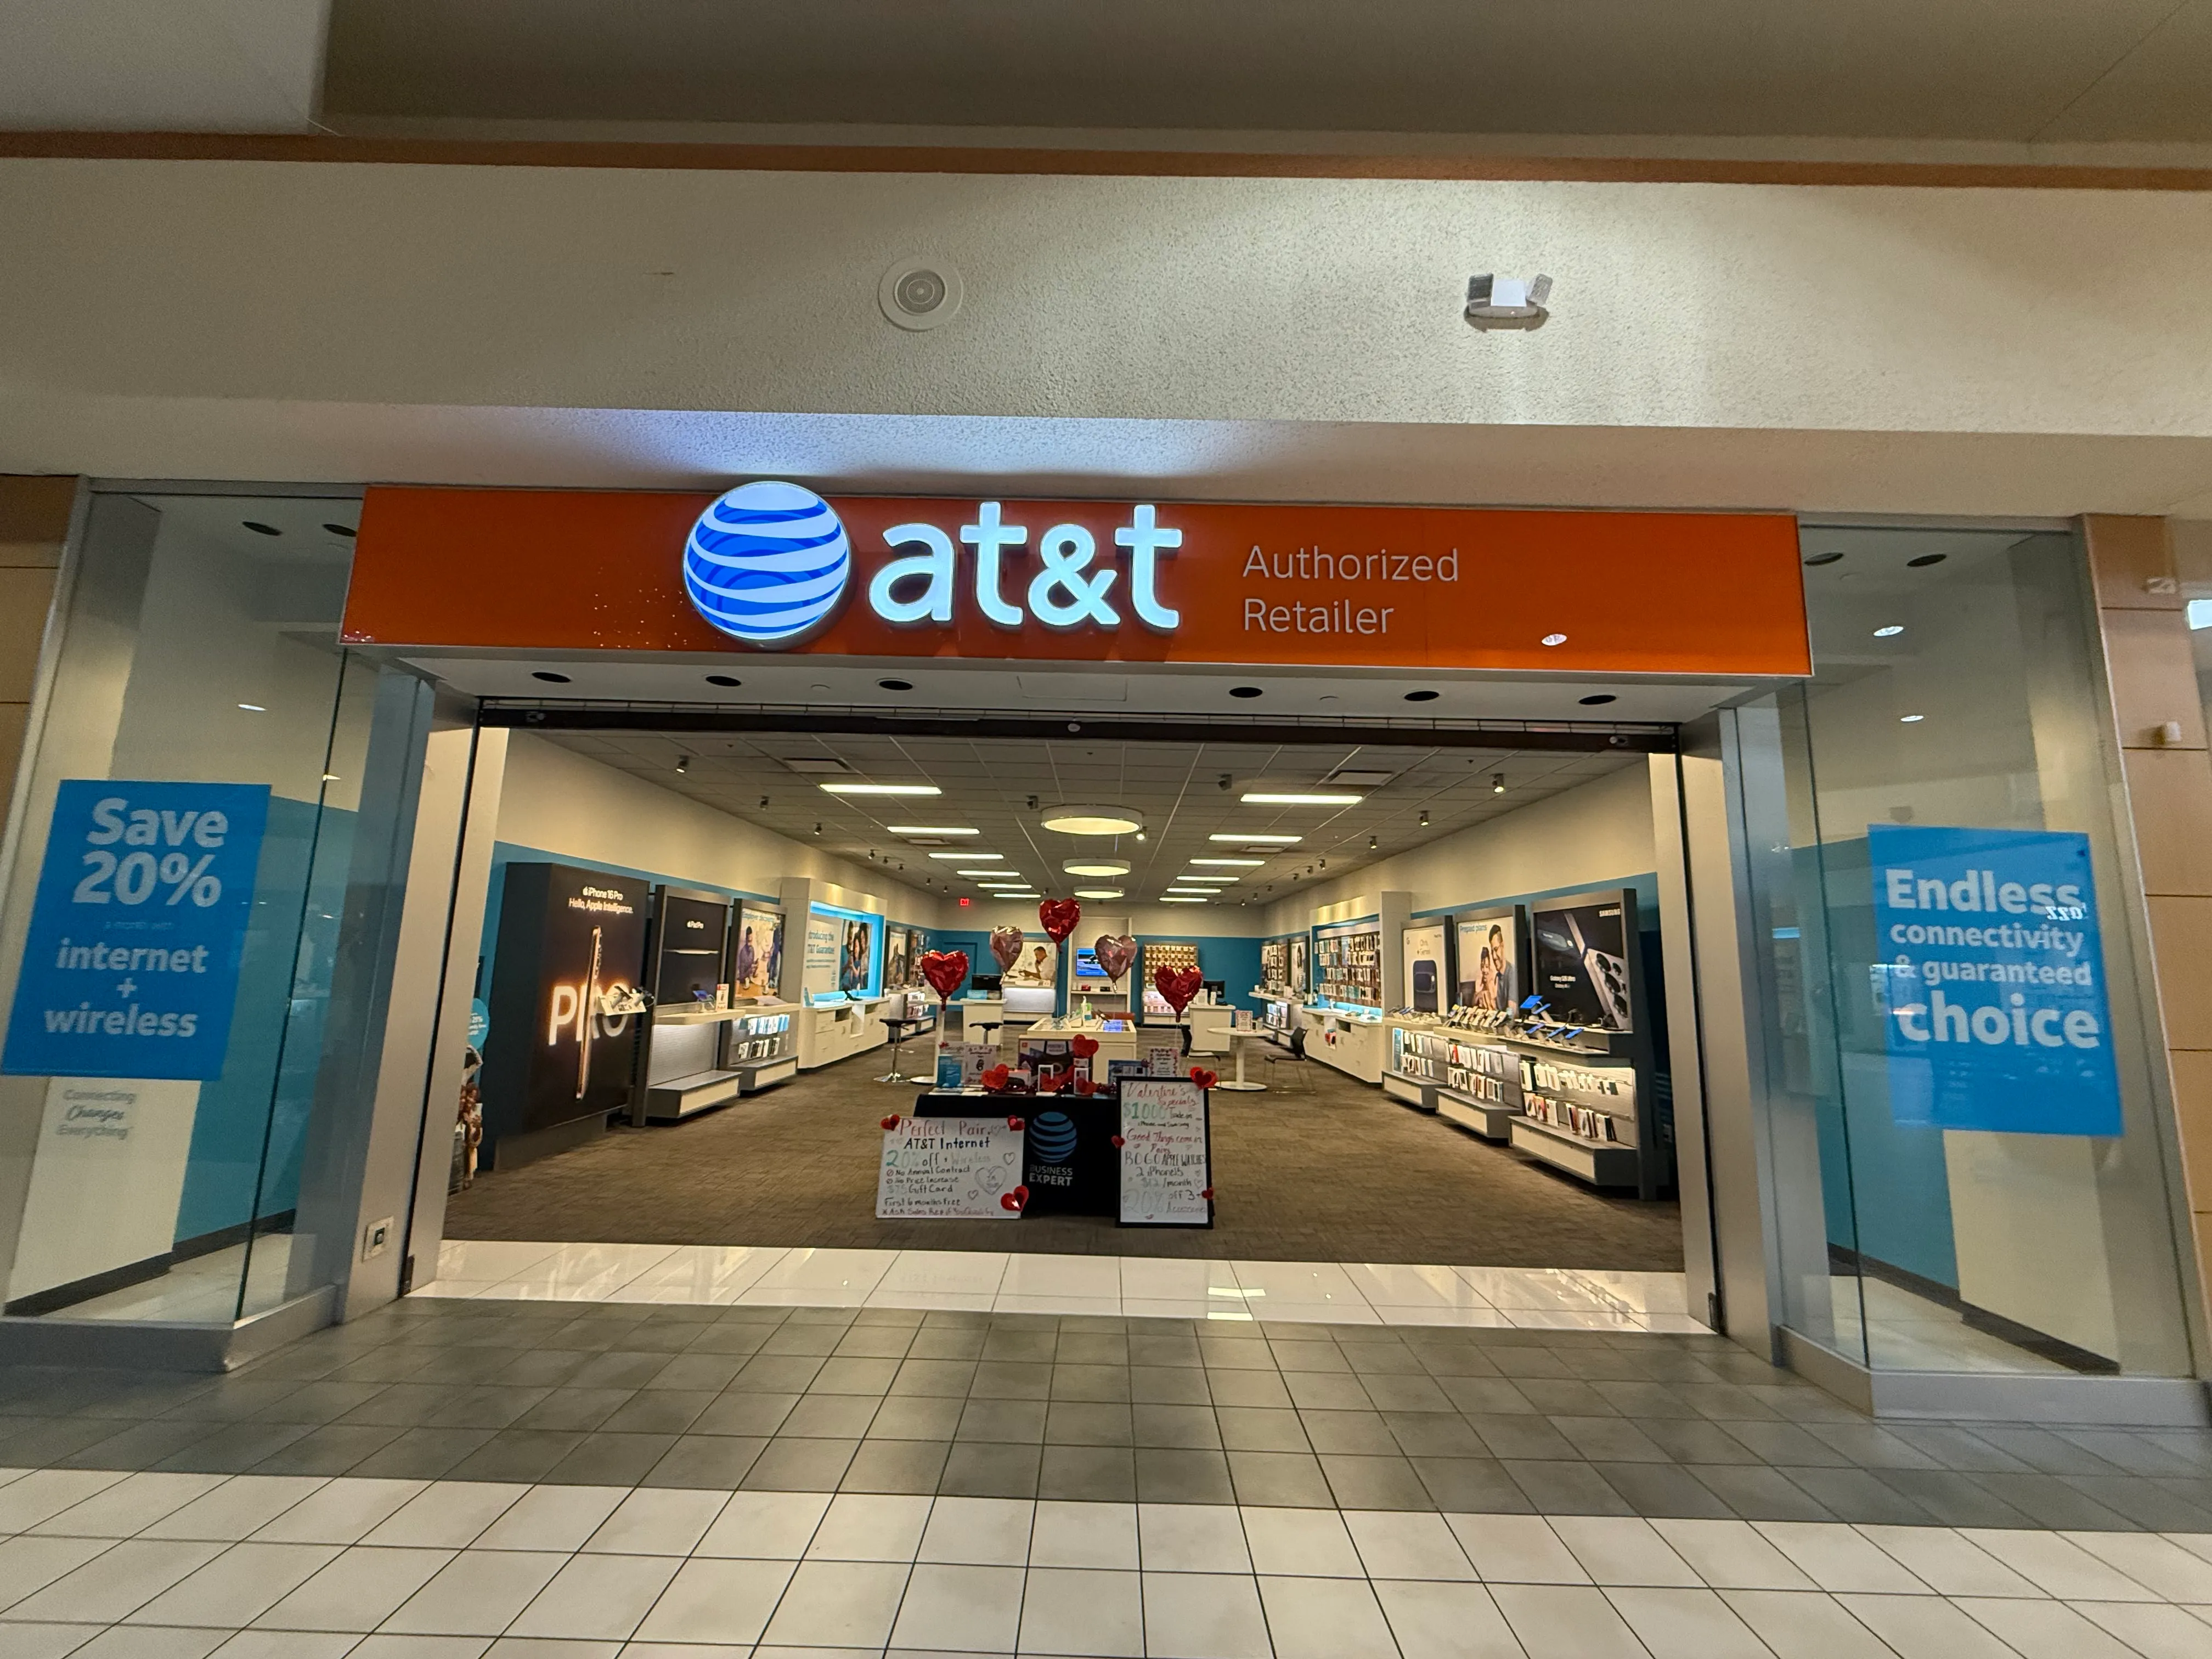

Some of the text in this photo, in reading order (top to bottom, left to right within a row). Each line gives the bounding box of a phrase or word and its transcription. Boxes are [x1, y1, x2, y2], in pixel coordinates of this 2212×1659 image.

[868, 501, 1183, 629] at&t
[1242, 545, 1459, 582] Authorized
[1242, 597, 1395, 634] Retailer
[86, 797, 228, 848] Save
[72, 850, 222, 907] 20%
[588, 887, 607, 899] iPhone
[614, 890, 624, 901] Pro
[1886, 868, 2084, 915] Endless
[586, 899, 603, 912] Apple
[1599, 909, 1621, 917] SAMSUNG
[1890, 922, 2084, 957] connectivity
[55, 937, 210, 973] internet
[1894, 954, 2092, 986] & guaranteed
[116, 977, 137, 998] +
[44, 1002, 198, 1037] wireless
[1897, 990, 2100, 1049] choice
[1126, 1082, 1186, 1098] Valentine's
[899, 1118, 945, 1137] Perfect
[1126, 1128, 1150, 1142] Good
[904, 1136, 991, 1150] AT&T Internet
[922, 1152, 940, 1167] off
[1125, 1150, 1161, 1166] BOGO
[935, 1165, 970, 1174] Contract
[1029, 1164, 1073, 1176] BUSINESS
[1135, 1166, 1144, 1177] 2
[927, 1176, 960, 1184] Increase
[1029, 1172, 1073, 1187] EXPERT
[909, 1184, 927, 1194] Gift
[929, 1183, 953, 1193] Card
[884, 1197, 905, 1206] First
